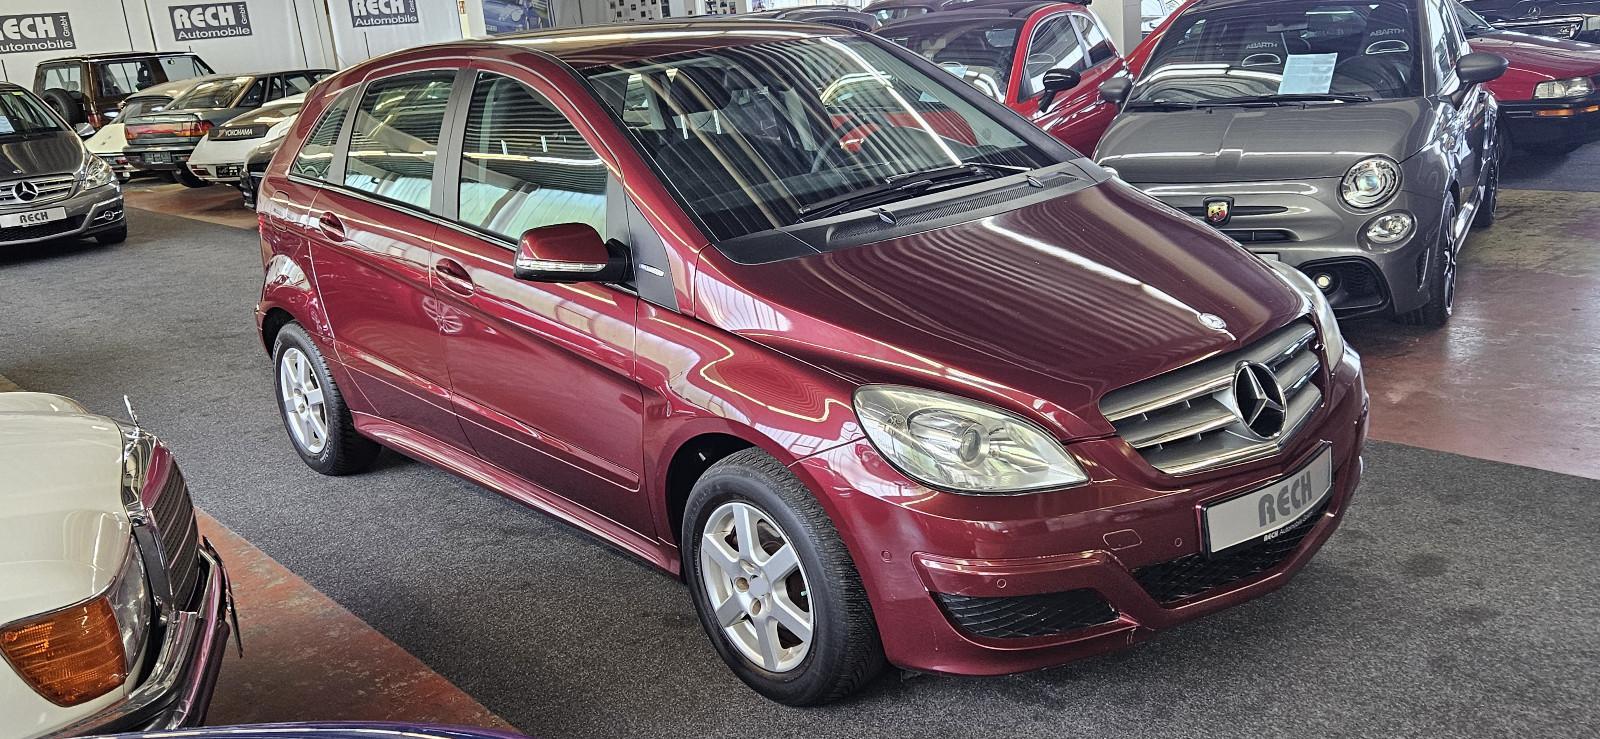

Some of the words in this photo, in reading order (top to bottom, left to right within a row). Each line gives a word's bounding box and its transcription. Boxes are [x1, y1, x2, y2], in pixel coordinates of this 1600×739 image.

[238, 4, 248, 24] GmbH
[352, 0, 405, 17] RECH
[173, 5, 236, 29] RECH
[355, 15, 417, 26] Automobile
[0, 16, 57, 40] ECH
[60, 15, 71, 37] GmbH
[1369, 28, 1405, 36] ABARTH
[178, 27, 250, 40] Automobile
[0, 39, 74, 52] utomobile
[1246, 41, 1278, 50] ABARTH
[225, 128, 253, 137] YOKOHAMA
[19, 211, 49, 224] RECH
[1259, 471, 1312, 527] RECH
